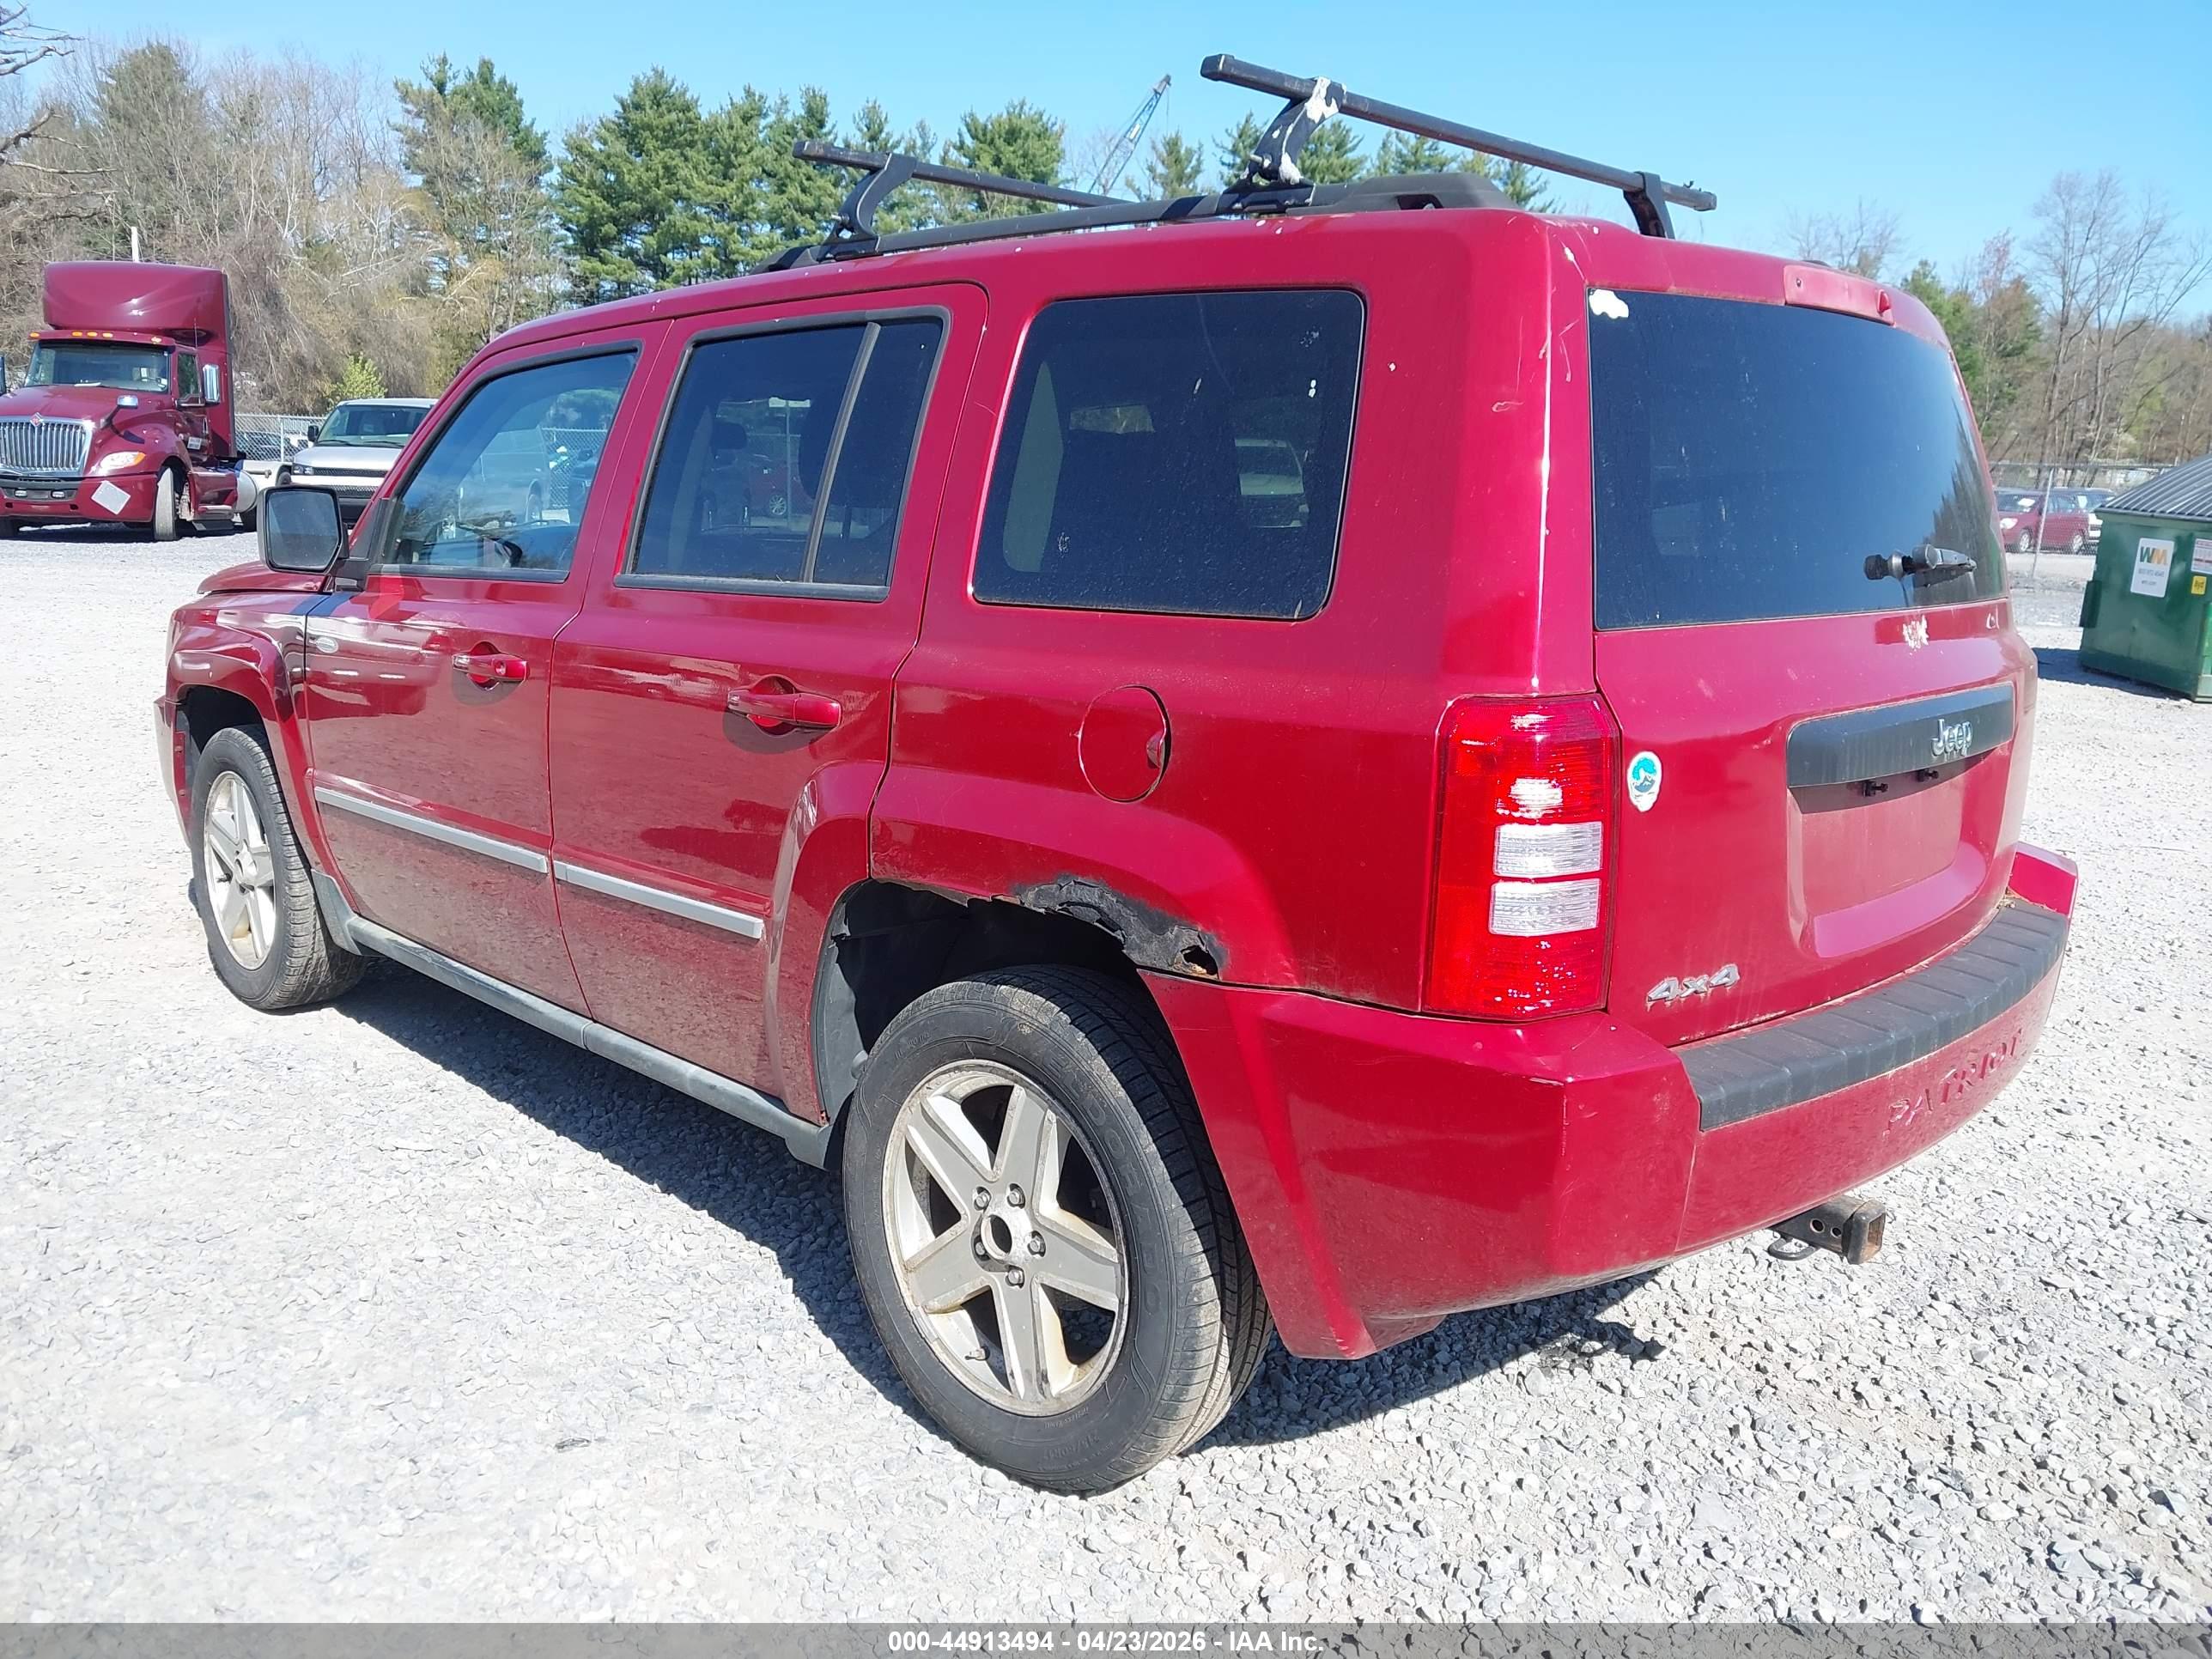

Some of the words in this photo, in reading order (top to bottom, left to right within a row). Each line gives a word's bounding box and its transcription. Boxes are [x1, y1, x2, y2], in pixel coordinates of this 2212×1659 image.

[2140, 547, 2168, 564] WM
[1931, 719, 1972, 757] Jeep
[1648, 964, 1739, 1002] 4x4
[1888, 1029, 2022, 1129] PATRIOT
